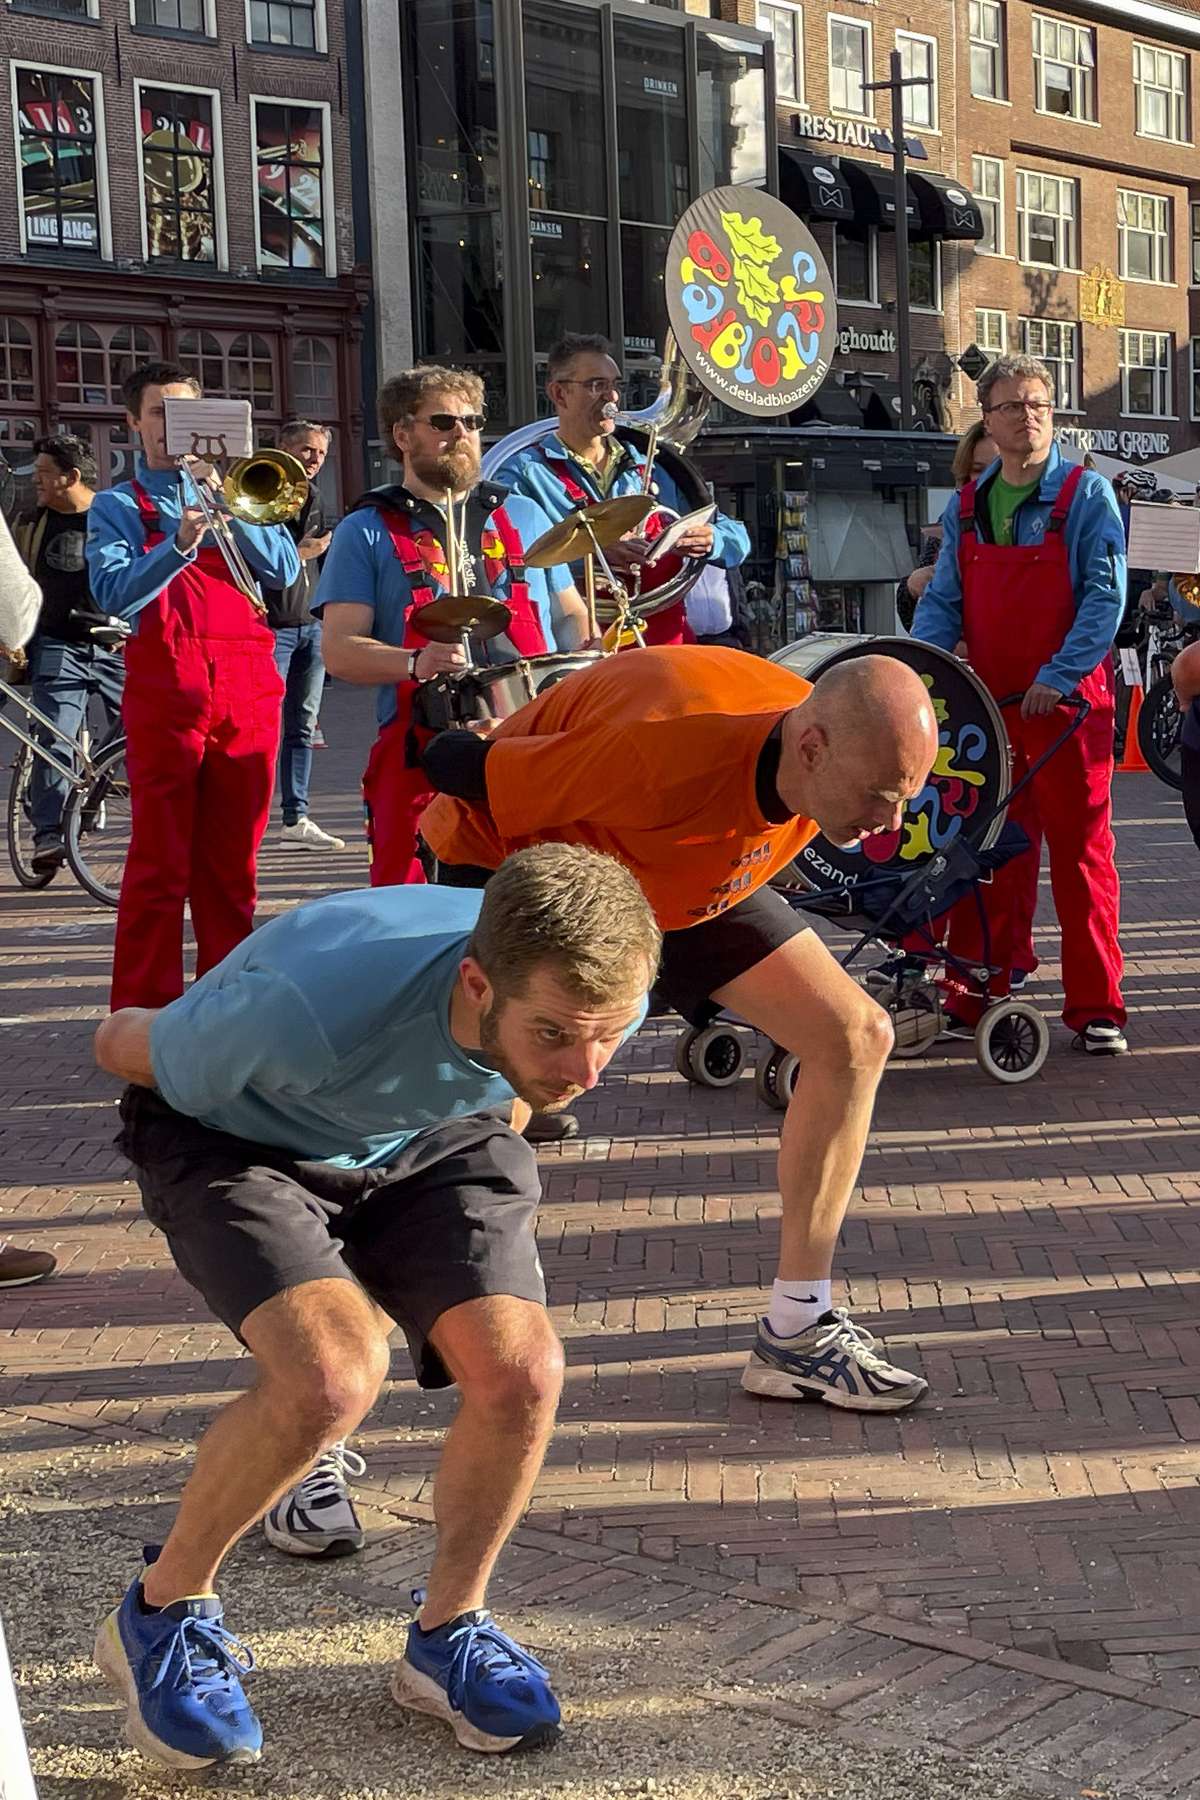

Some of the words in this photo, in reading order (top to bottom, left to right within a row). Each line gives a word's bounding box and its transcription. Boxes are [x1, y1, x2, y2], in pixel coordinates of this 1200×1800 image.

[643, 77, 678, 93] DRINKEN
[694, 351, 828, 407] www.debladbloazers.nl
[1120, 431, 1170, 459] GRENE
